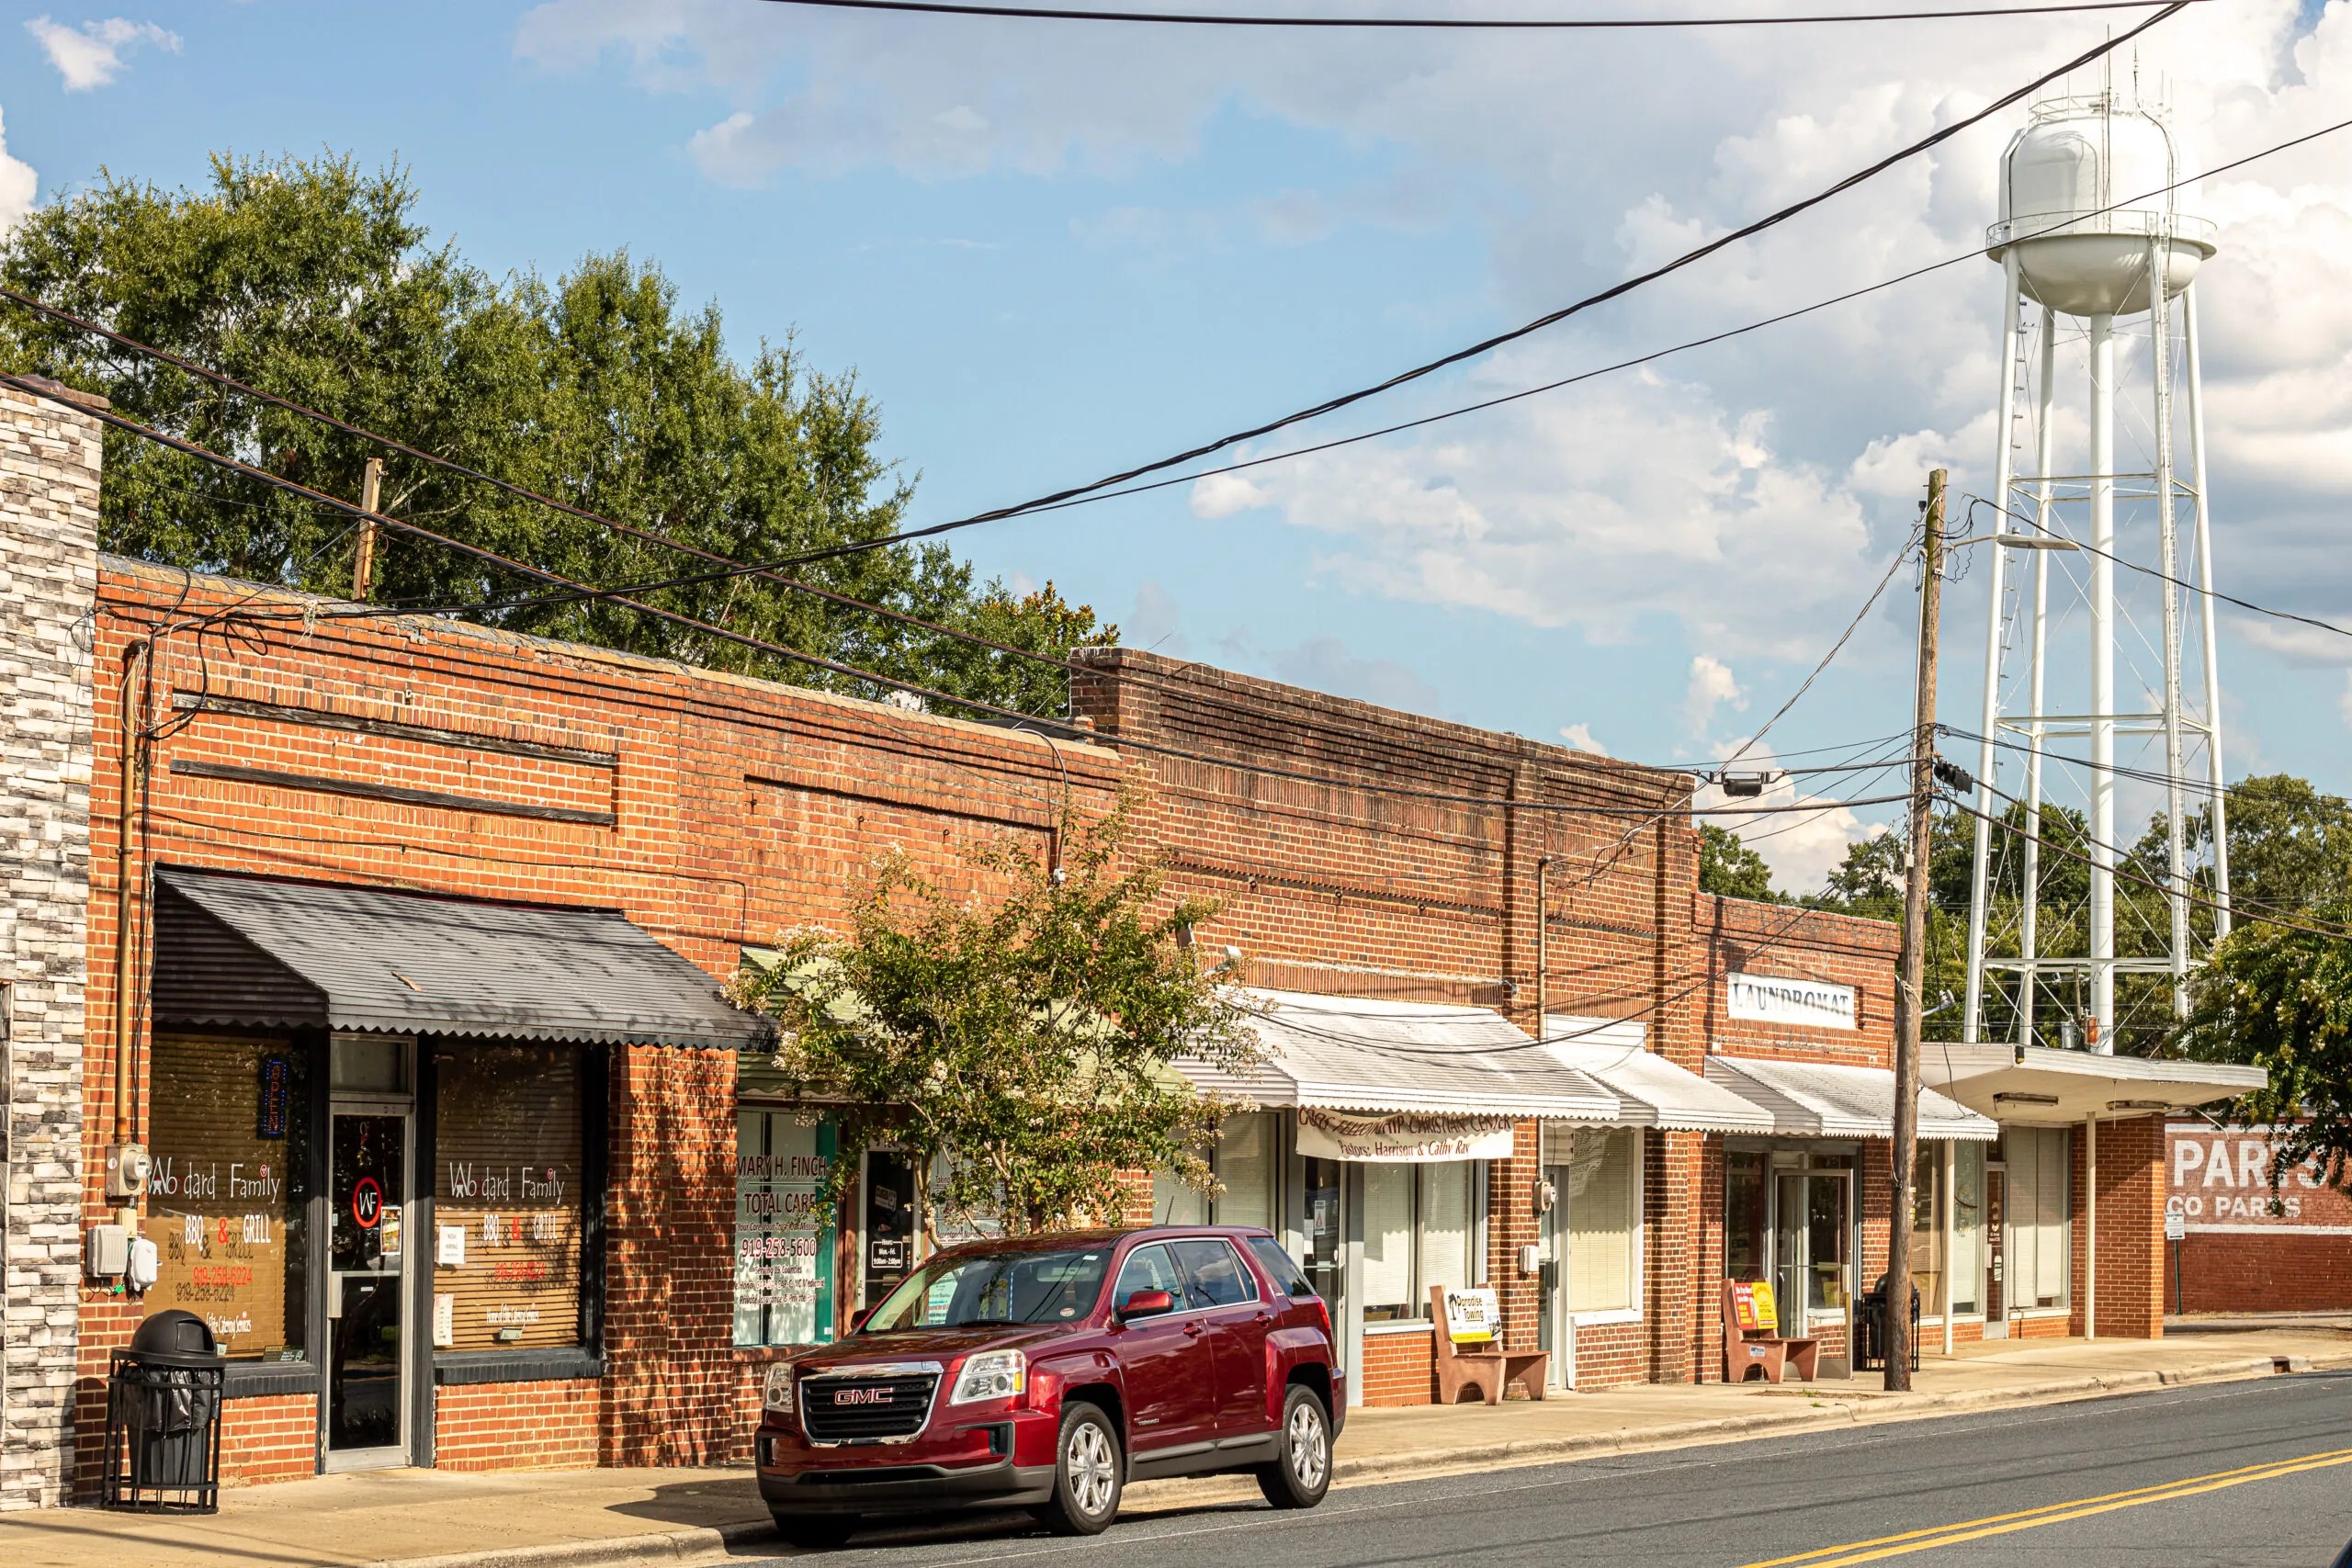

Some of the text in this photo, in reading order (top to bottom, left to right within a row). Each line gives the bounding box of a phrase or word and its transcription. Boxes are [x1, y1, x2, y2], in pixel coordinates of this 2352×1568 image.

[1733, 982, 1849, 1016] LAUNDROMAT
[269, 1065, 280, 1131] OPEN
[1408, 1114, 1467, 1134] CHRISTIAN
[1470, 1111, 1511, 1133] CENTER
[1338, 1139, 1372, 1157] Pastors:
[1374, 1141, 1414, 1156] Harrison
[1418, 1141, 1425, 1156] &
[736, 1156, 827, 1177] MARY H. FINCH
[230, 1163, 281, 1204] Family
[521, 1167, 565, 1205] Family
[359, 1191, 378, 1216] WF
[744, 1193, 782, 1214] TOTAL
[185, 1214, 204, 1250] BBQ
[218, 1218, 230, 1245] &
[243, 1213, 272, 1245] GRILL
[483, 1213, 500, 1247] BBQ
[511, 1216, 522, 1241] &
[534, 1213, 558, 1241] GRILL
[741, 1237, 816, 1258] 919-258-5600
[193, 1266, 253, 1286] 919-258-6224
[1456, 1295, 1482, 1314] Paradise
[1464, 1308, 1484, 1322] Towing
[835, 1387, 894, 1405] GMC
